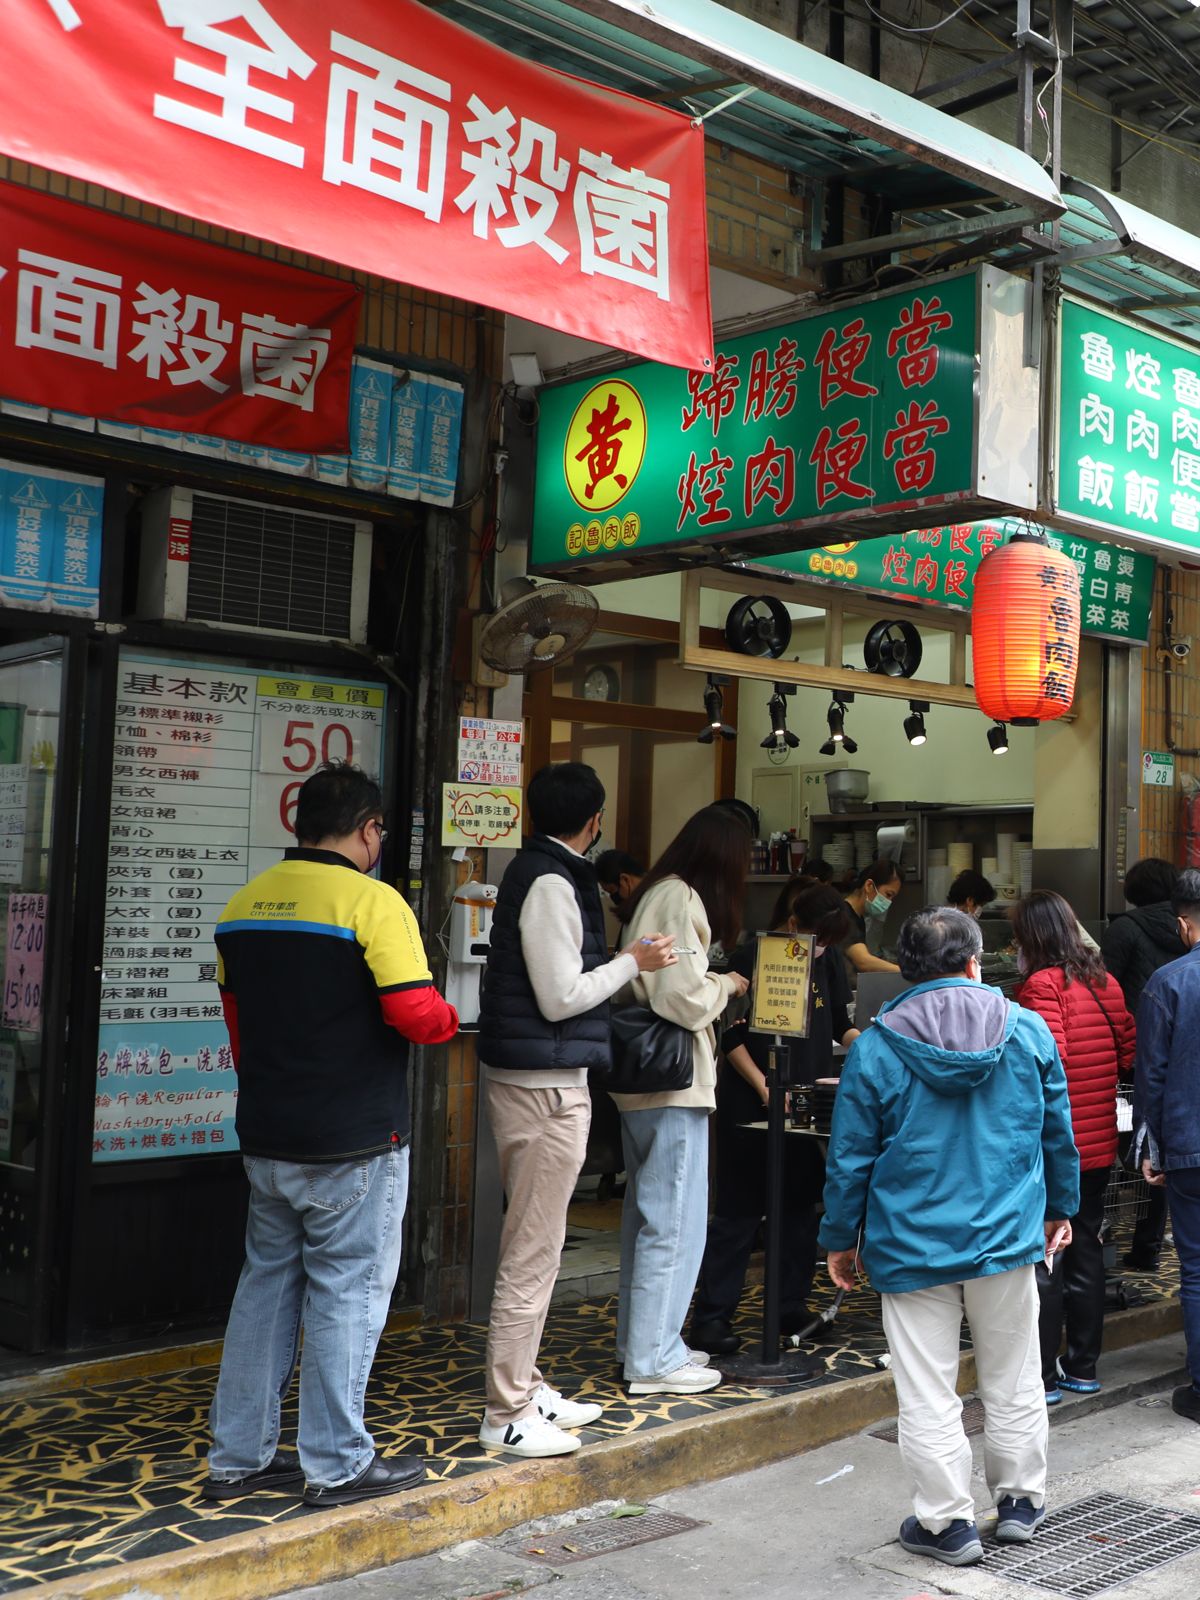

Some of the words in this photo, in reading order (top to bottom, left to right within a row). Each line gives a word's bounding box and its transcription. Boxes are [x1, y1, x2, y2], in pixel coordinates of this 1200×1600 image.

[45, 0, 671, 302] 全面殺菌
[0, 247, 331, 412] 面殺菌
[680, 297, 952, 437] 蹄膀便當
[1077, 331, 1116, 510] 魯肉飯
[575, 394, 632, 499] 黃
[170, 523, 190, 556] 三洋
[568, 519, 637, 550] 記魯肉飯
[880, 545, 976, 598] 焢肉便
[1086, 549, 1111, 626] 魯白菜
[123, 671, 249, 705] 基本款
[274, 680, 369, 705] 會員價
[117, 704, 224, 725] 男標準襯衫
[260, 700, 377, 721] 不分乾洗或水洗
[114, 744, 158, 759] 領帶
[282, 720, 353, 773] 50
[113, 764, 200, 781] 男女西褲
[1156, 770, 1167, 783] 28
[111, 785, 156, 798] 毛衣
[111, 804, 177, 820] 女短裙
[475, 805, 511, 816] 請多注意
[110, 825, 154, 838] 背心
[109, 845, 239, 861] 男女西裝上衣
[107, 886, 151, 898] 外套
[106, 906, 150, 918] 大衣
[11, 924, 43, 952] 12:00
[105, 926, 150, 939] 洋裝
[104, 947, 193, 959] 過膝長裙
[102, 987, 168, 999] 床罩組
